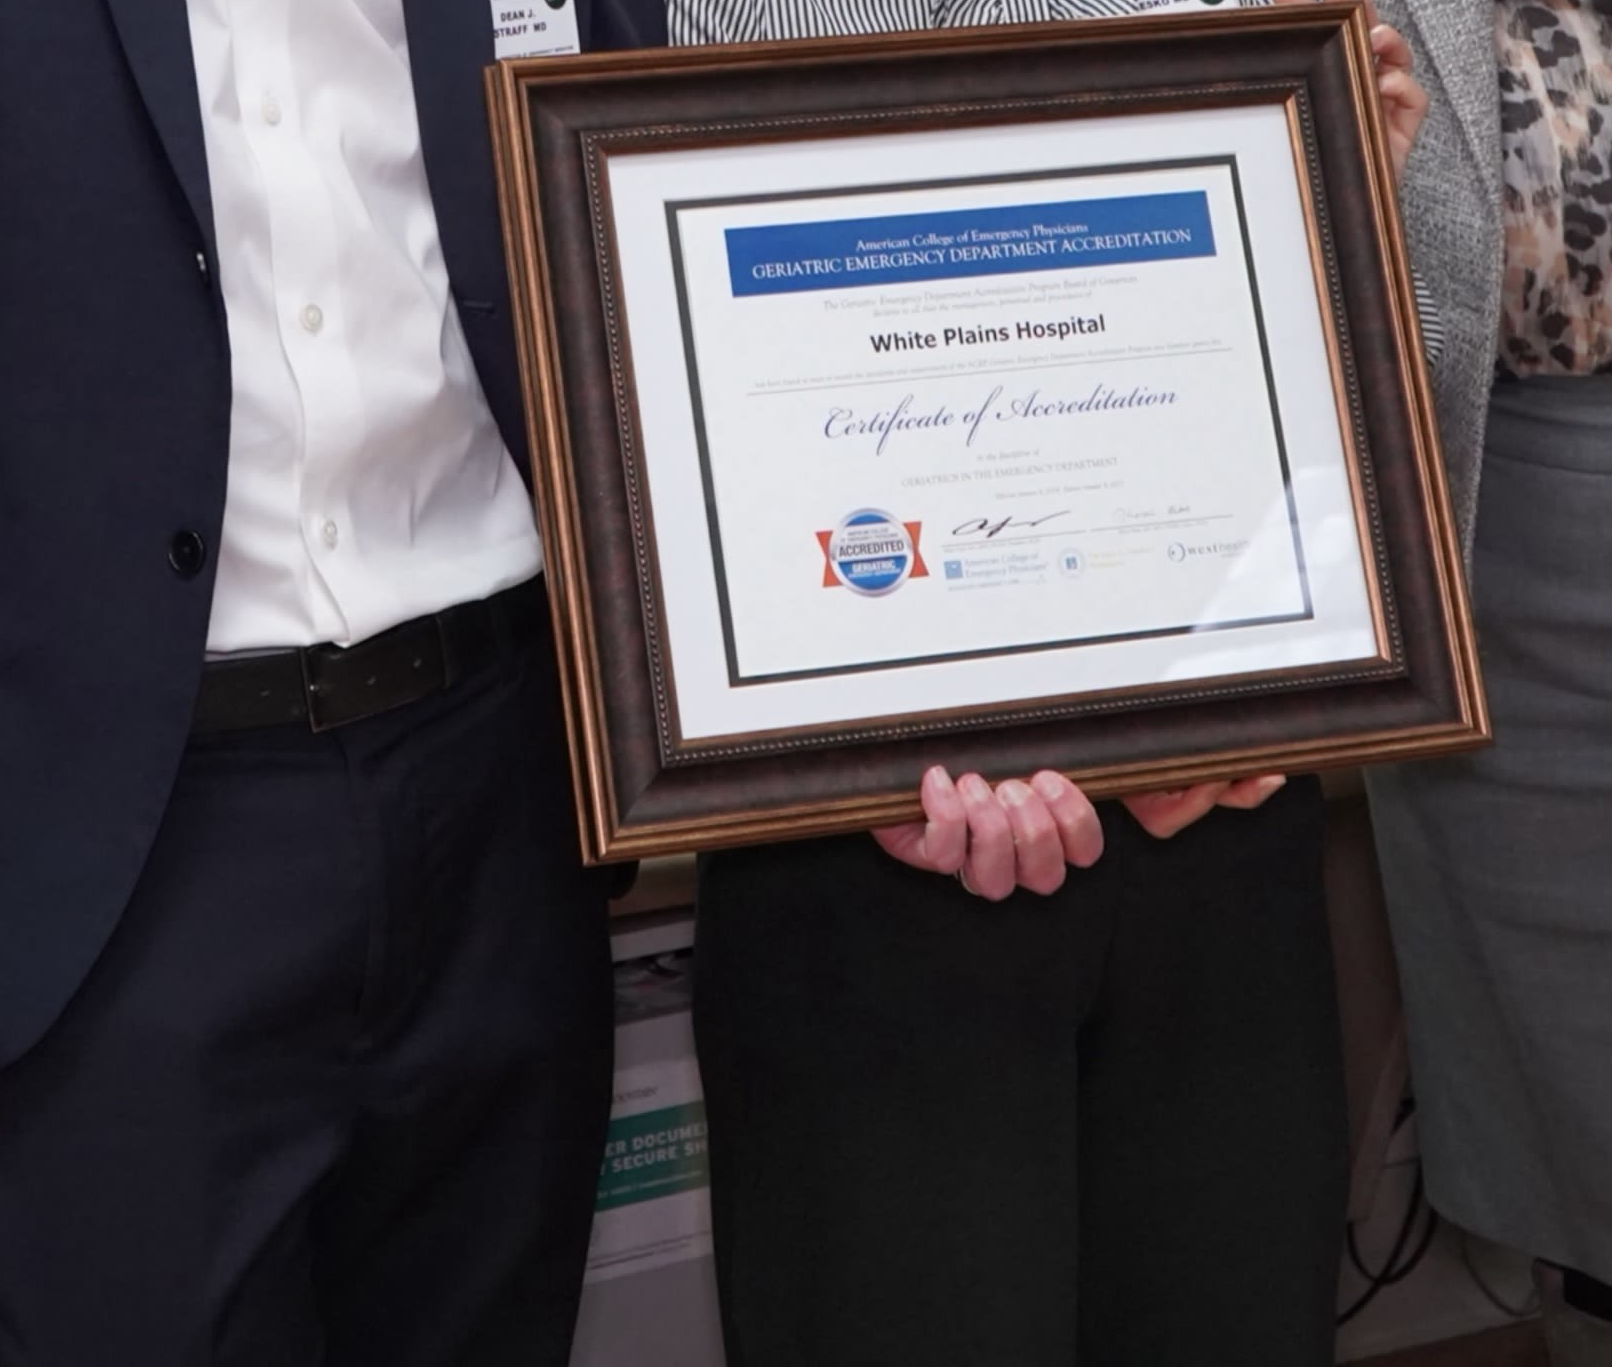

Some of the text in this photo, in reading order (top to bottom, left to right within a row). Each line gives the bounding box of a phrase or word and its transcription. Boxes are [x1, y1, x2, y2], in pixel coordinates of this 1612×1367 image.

[493, 21, 547, 39] STRAFF MD
[500, 9, 537, 23] DEAN J.
[855, 223, 1089, 253] American College of Emergency Physicians
[752, 228, 1192, 280] GERIATRIC EMERGENCY DEPARTMENT ACCREDITATION
[870, 314, 1106, 354] White Plains Hospital
[824, 382, 1179, 456] Certificate of Accreditation
[839, 539, 904, 558] ACCREDITED
[632, 1123, 708, 1152] DOCUME
[612, 1148, 678, 1174] SECURE
